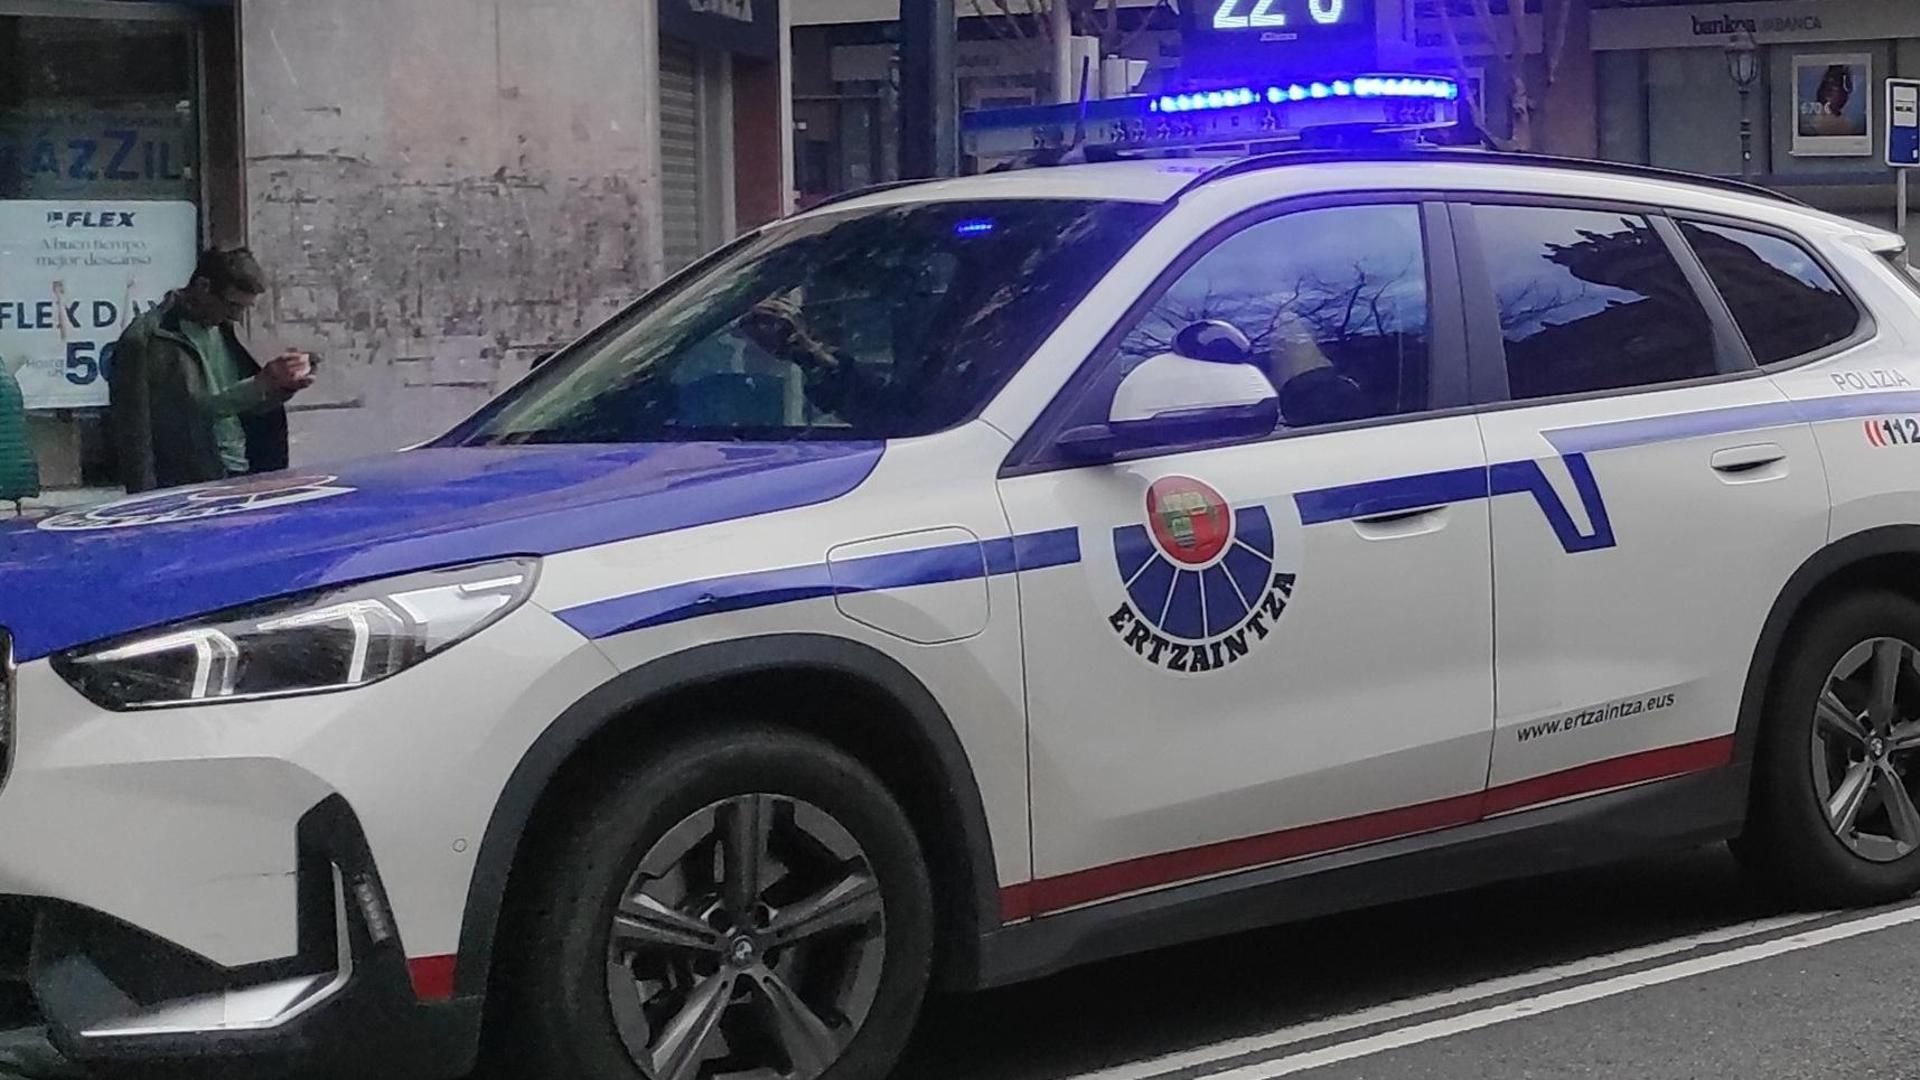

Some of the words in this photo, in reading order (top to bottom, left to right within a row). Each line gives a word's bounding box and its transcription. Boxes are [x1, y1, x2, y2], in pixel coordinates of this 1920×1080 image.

[66, 211, 136, 228] FLEX
[0, 301, 81, 329] FLEX
[1830, 369, 1912, 391] POLIZIA
[1883, 418, 1920, 445] 112
[1108, 573, 1297, 673] ERTZAINTZA
[1517, 693, 1675, 742] www.ertzaintza.eus
